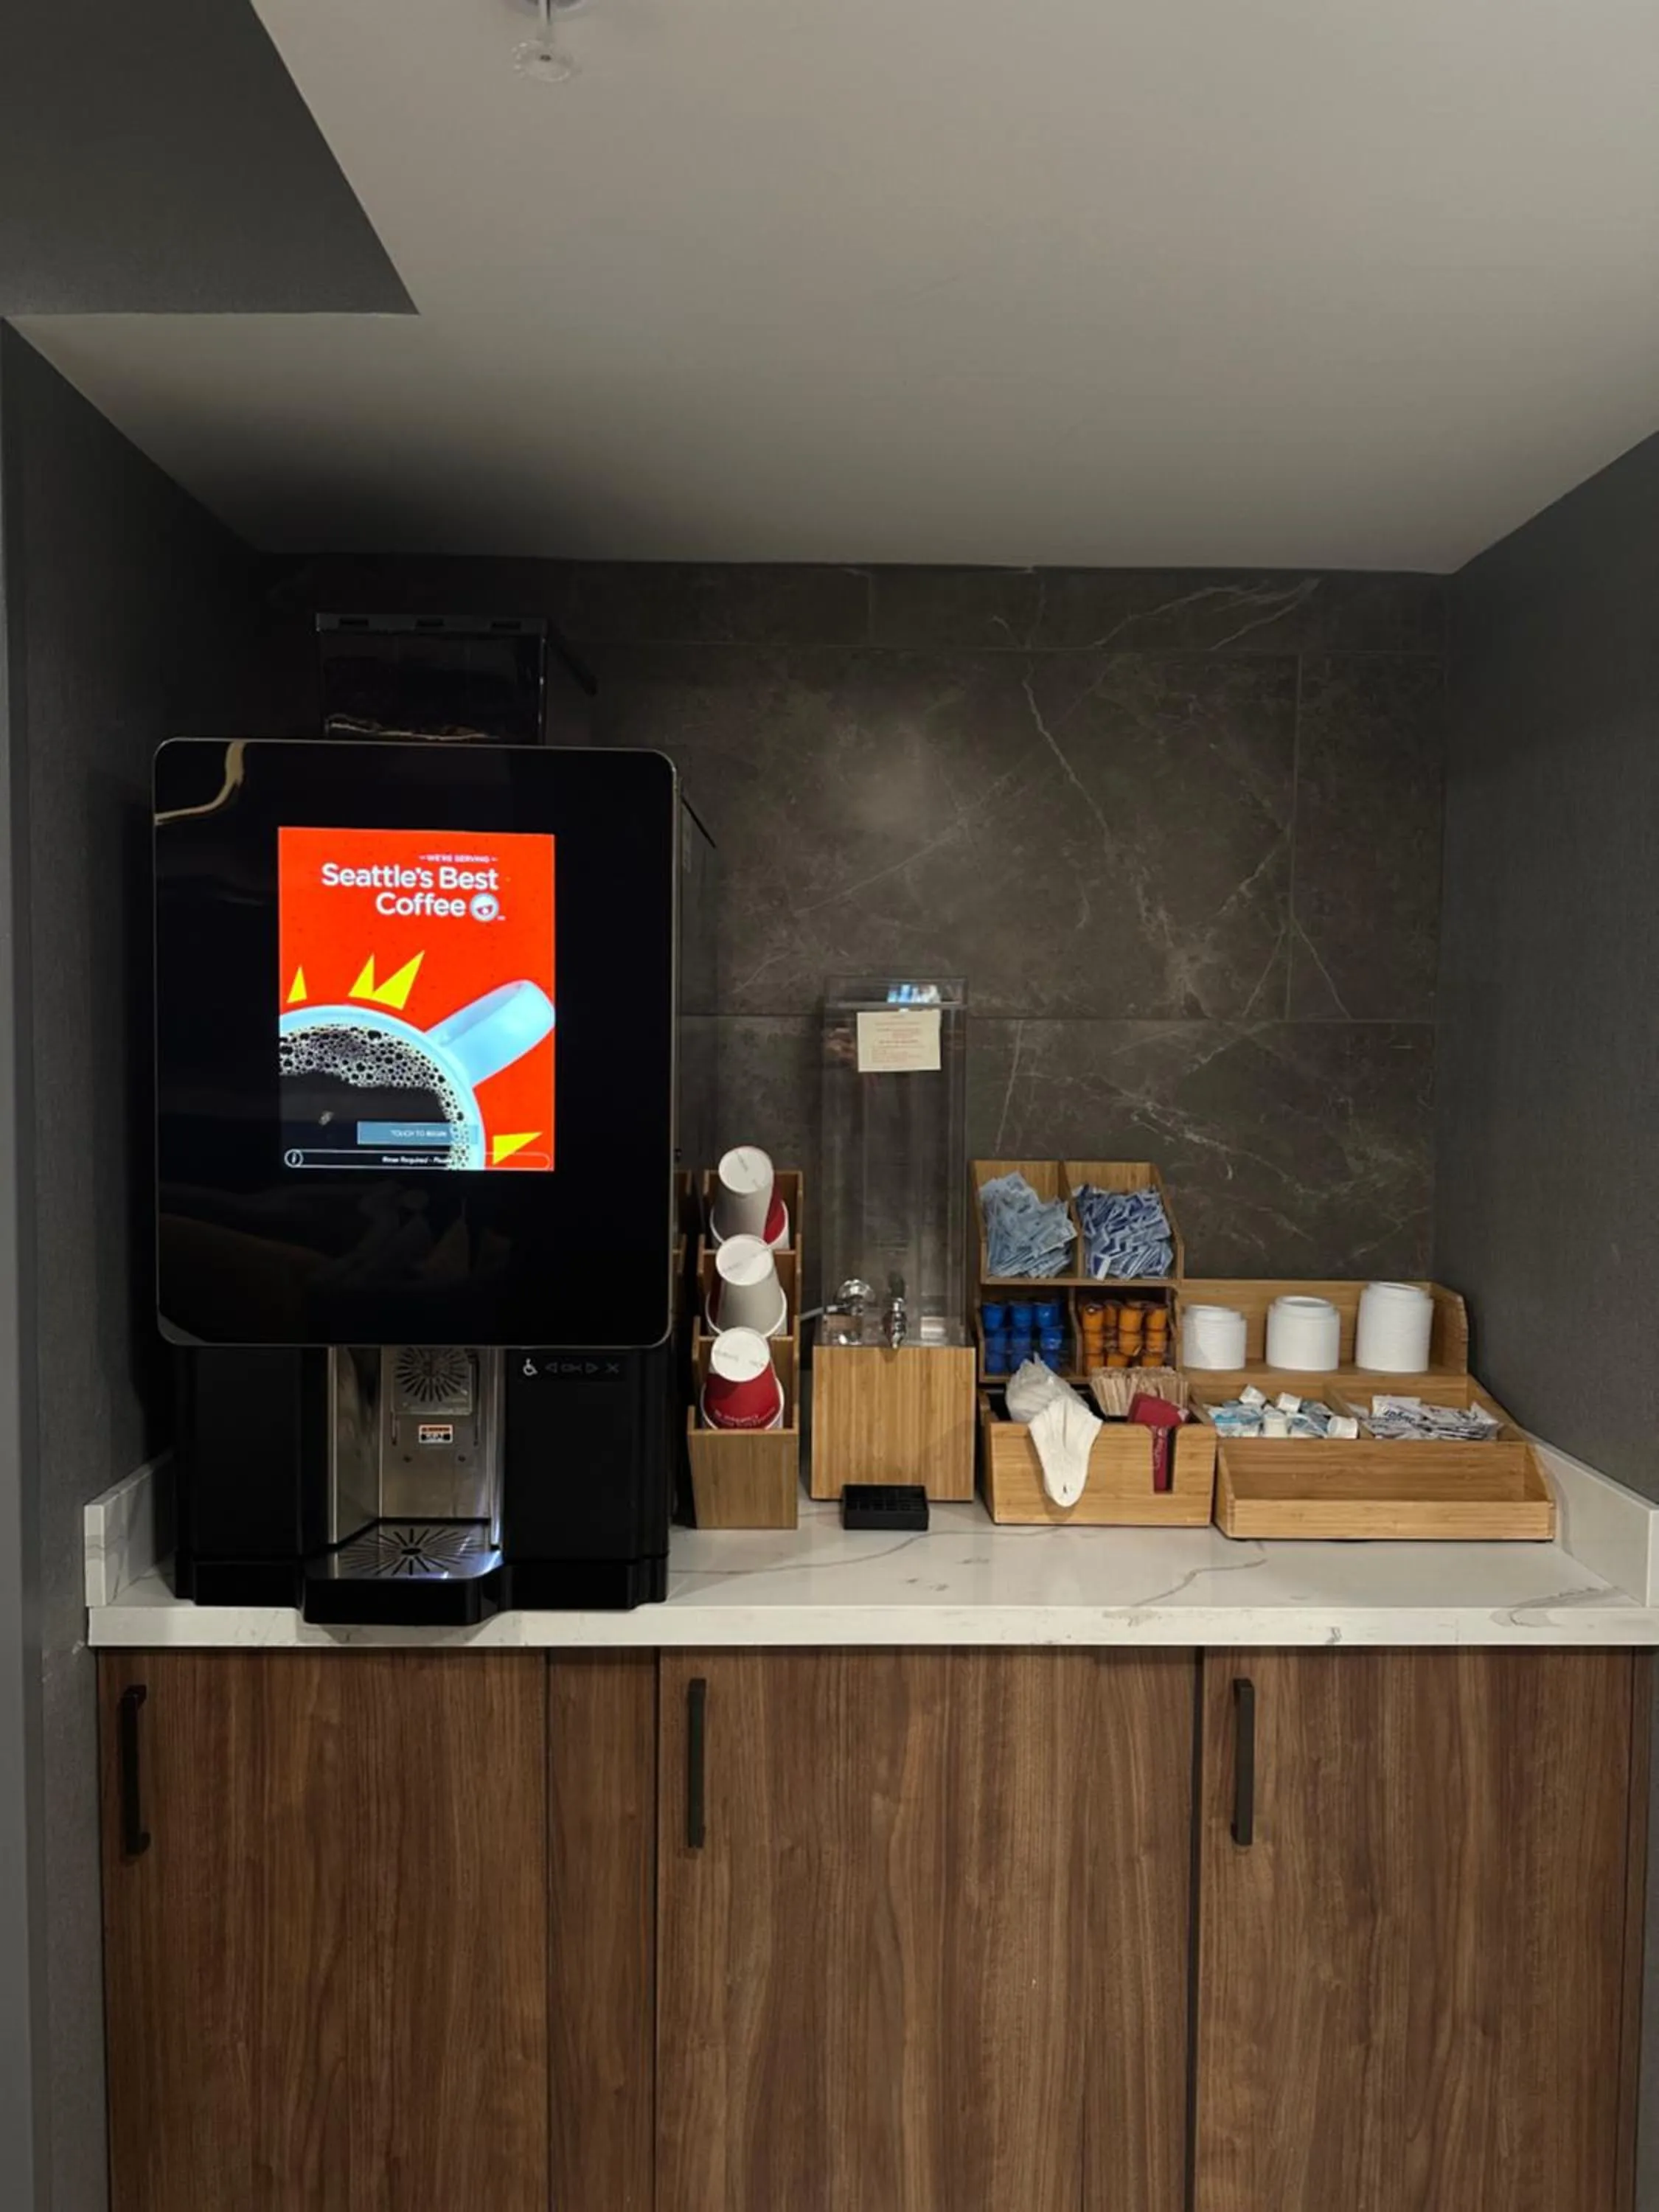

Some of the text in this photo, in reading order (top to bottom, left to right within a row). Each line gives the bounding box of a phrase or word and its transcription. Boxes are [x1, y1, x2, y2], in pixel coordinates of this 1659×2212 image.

[321, 862, 499, 890] Seattle's Best
[375, 891, 466, 917] Coffee
